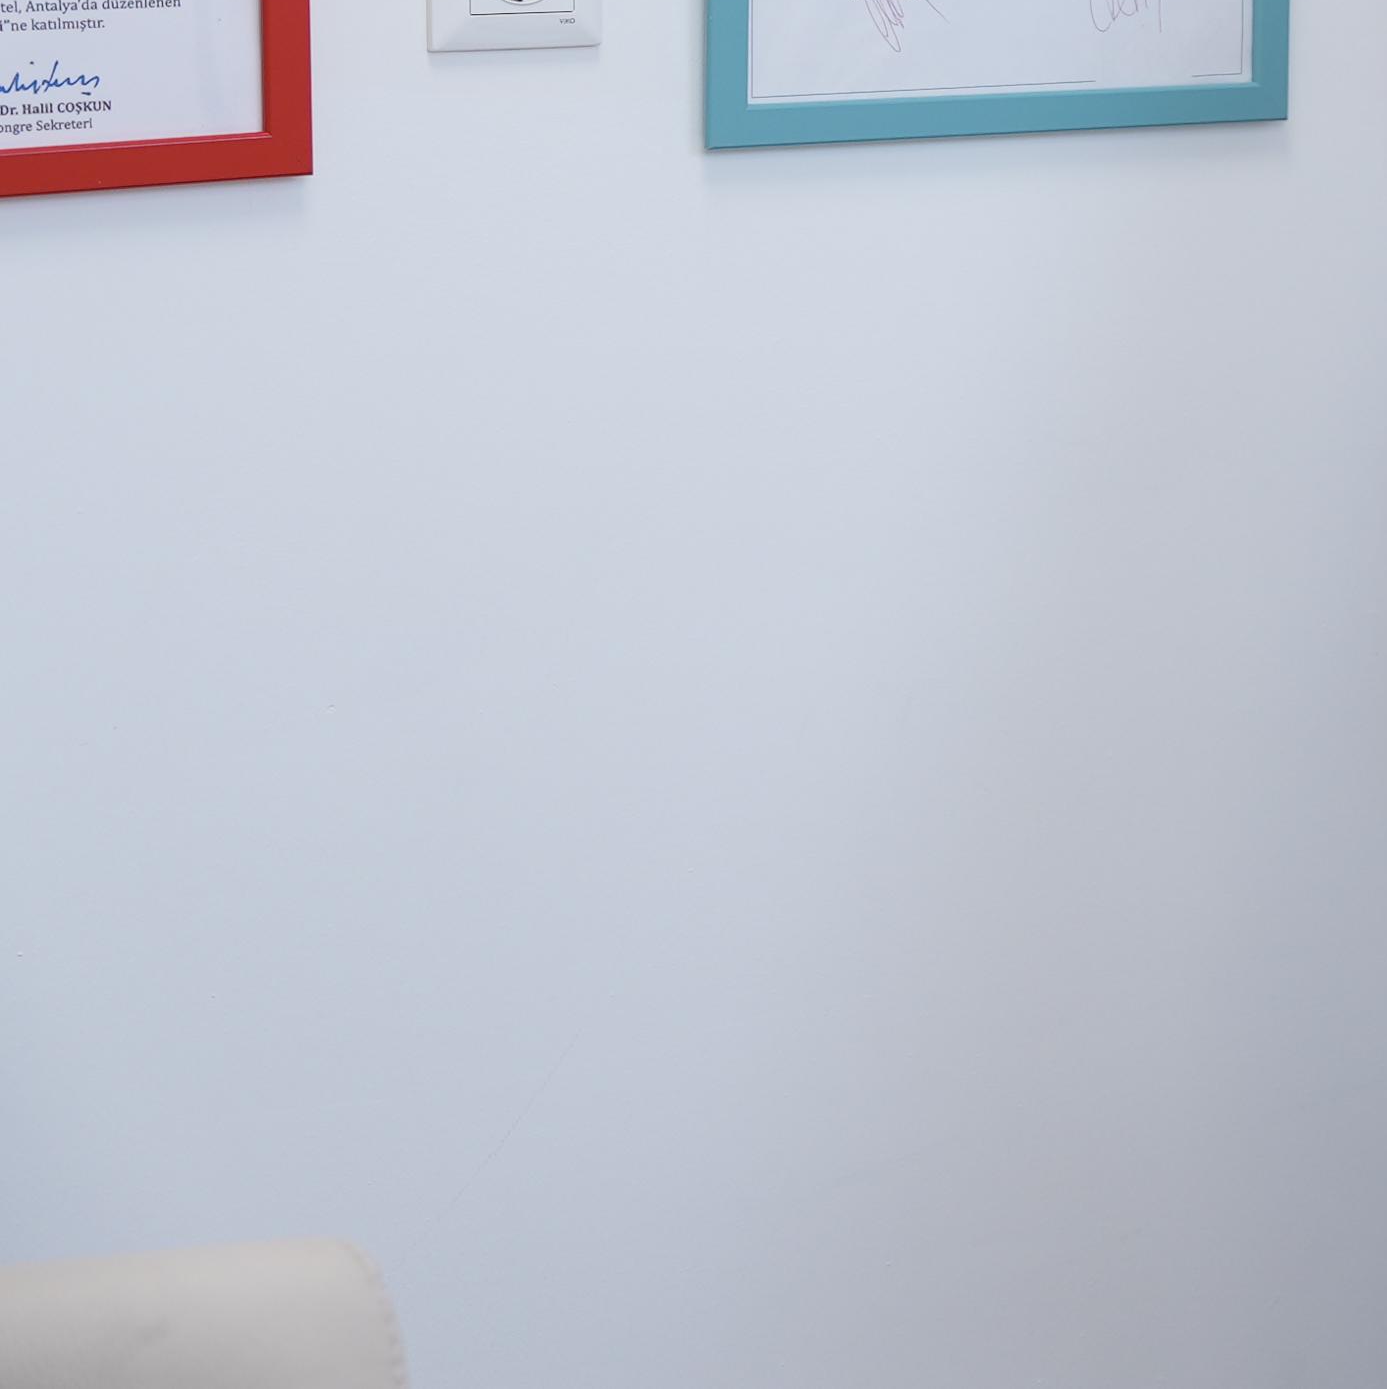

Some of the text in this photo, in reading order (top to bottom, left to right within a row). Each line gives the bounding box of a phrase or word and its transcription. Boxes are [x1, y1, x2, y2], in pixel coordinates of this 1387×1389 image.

[31, 17, 106, 32] katılmıştır.
[0, 100, 112, 116] Dr. Halil COŞKUN
[36, 117, 92, 131] Sekreteri
